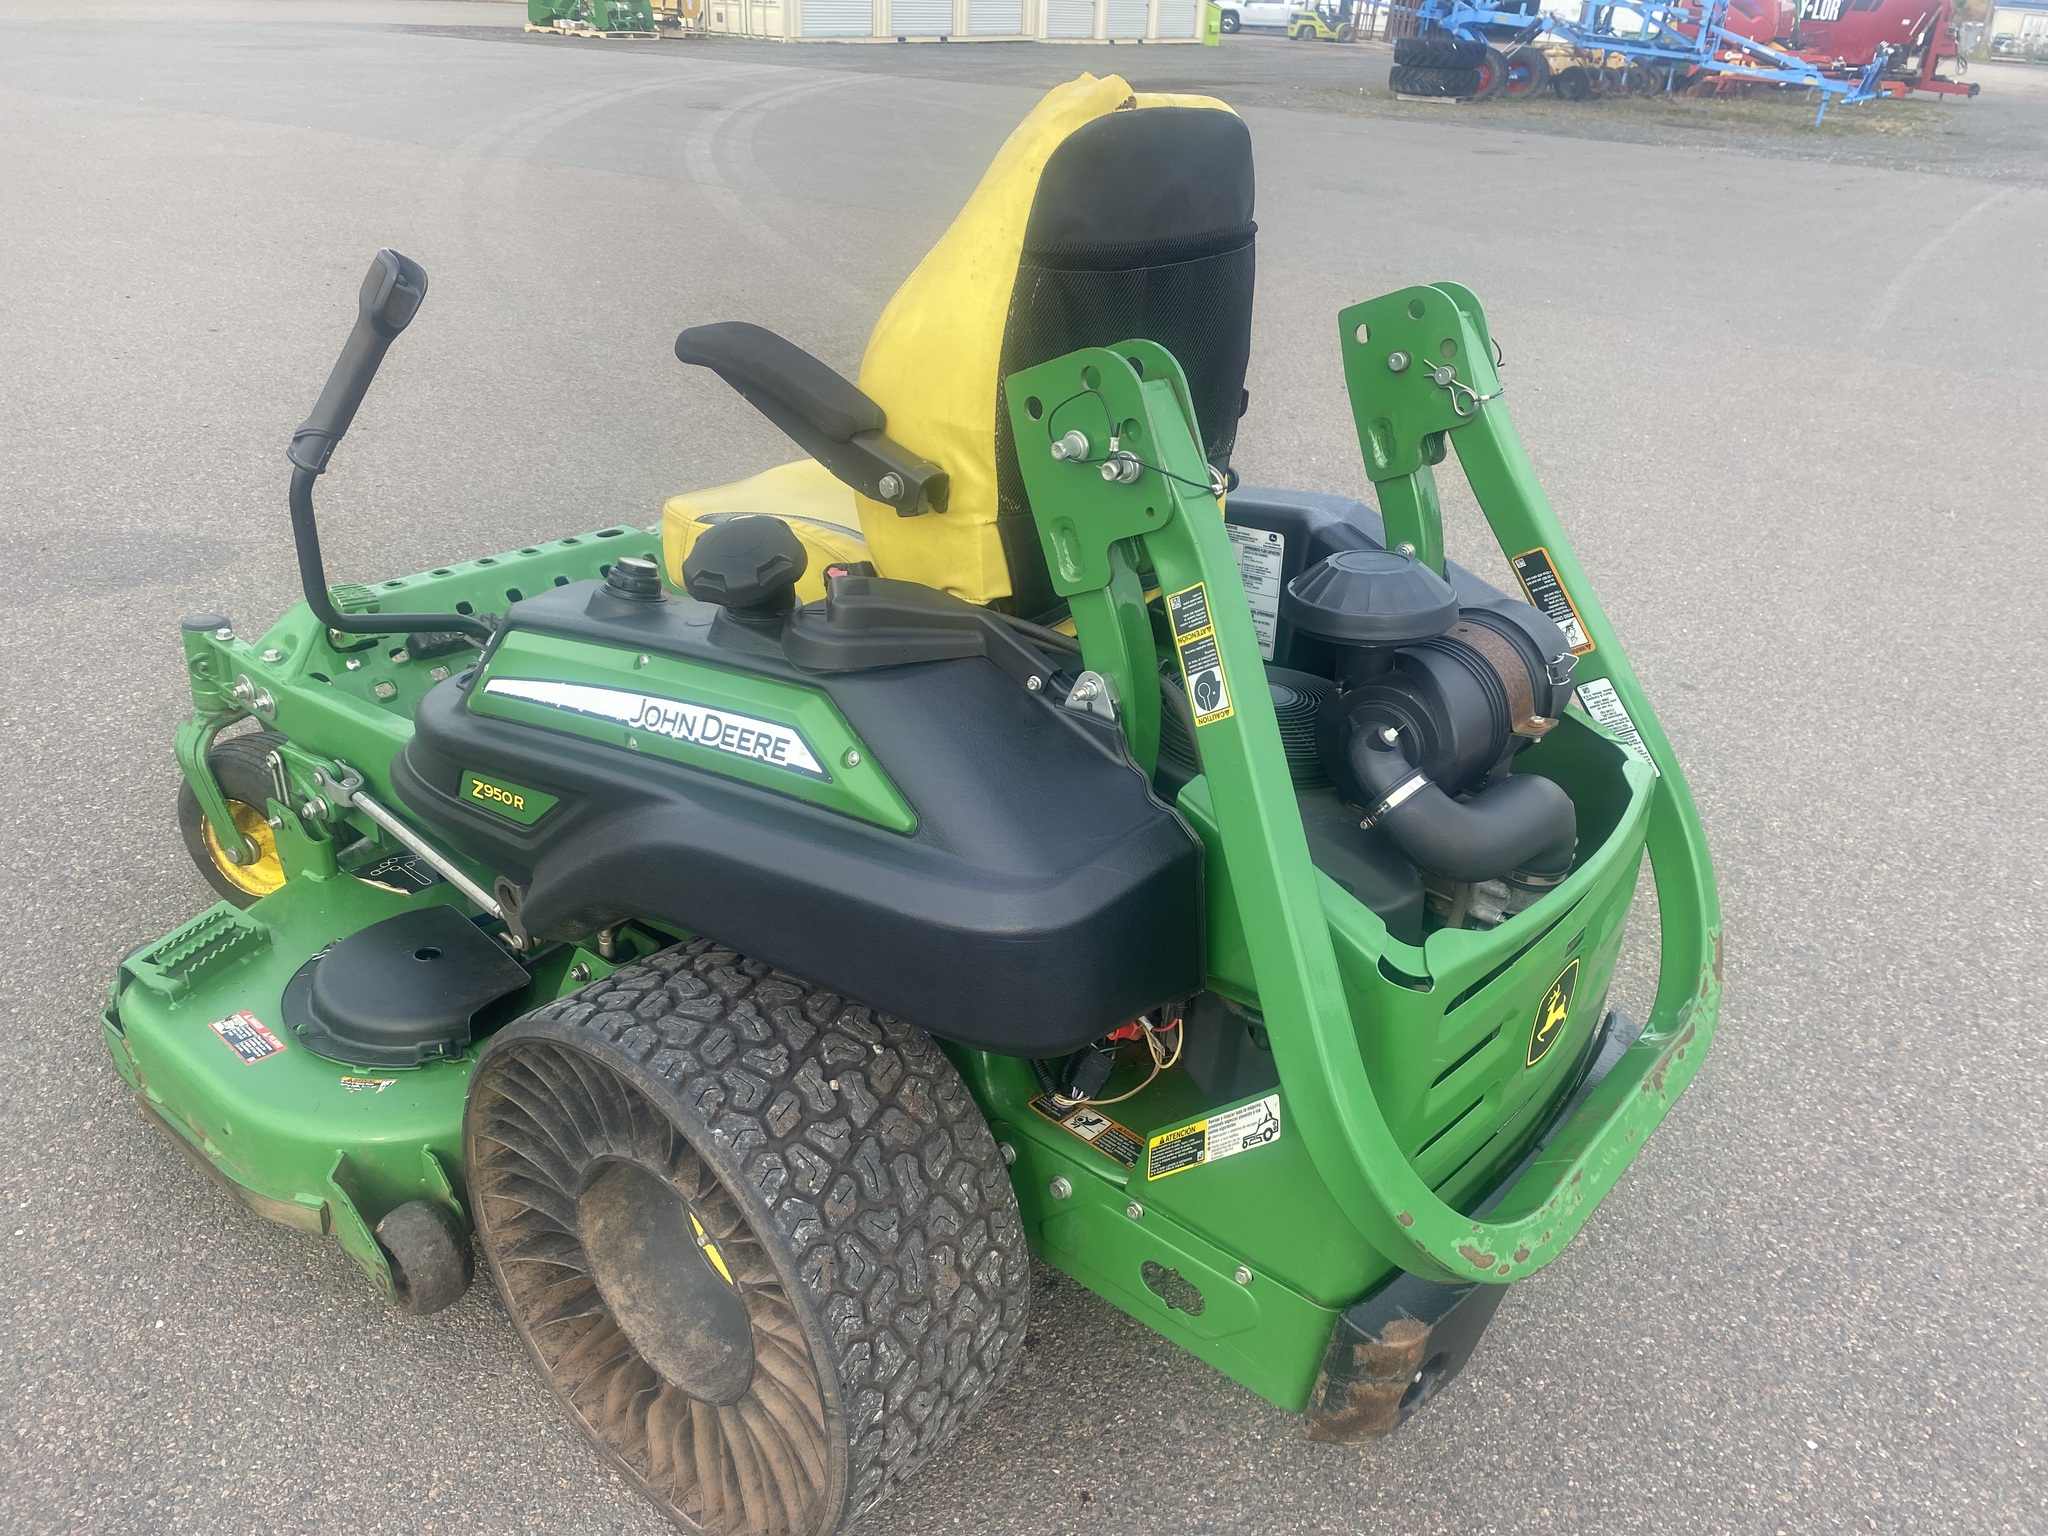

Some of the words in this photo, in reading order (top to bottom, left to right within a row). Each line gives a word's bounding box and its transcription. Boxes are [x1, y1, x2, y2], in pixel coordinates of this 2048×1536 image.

[1177, 628, 1207, 644] ATENCIÓN
[1198, 710, 1226, 725] CAUTION
[630, 699, 697, 737] JOHN
[701, 714, 791, 762] DEERE
[472, 779, 524, 811] Z950R
[1166, 1126, 1196, 1142] ATENCIÓN
